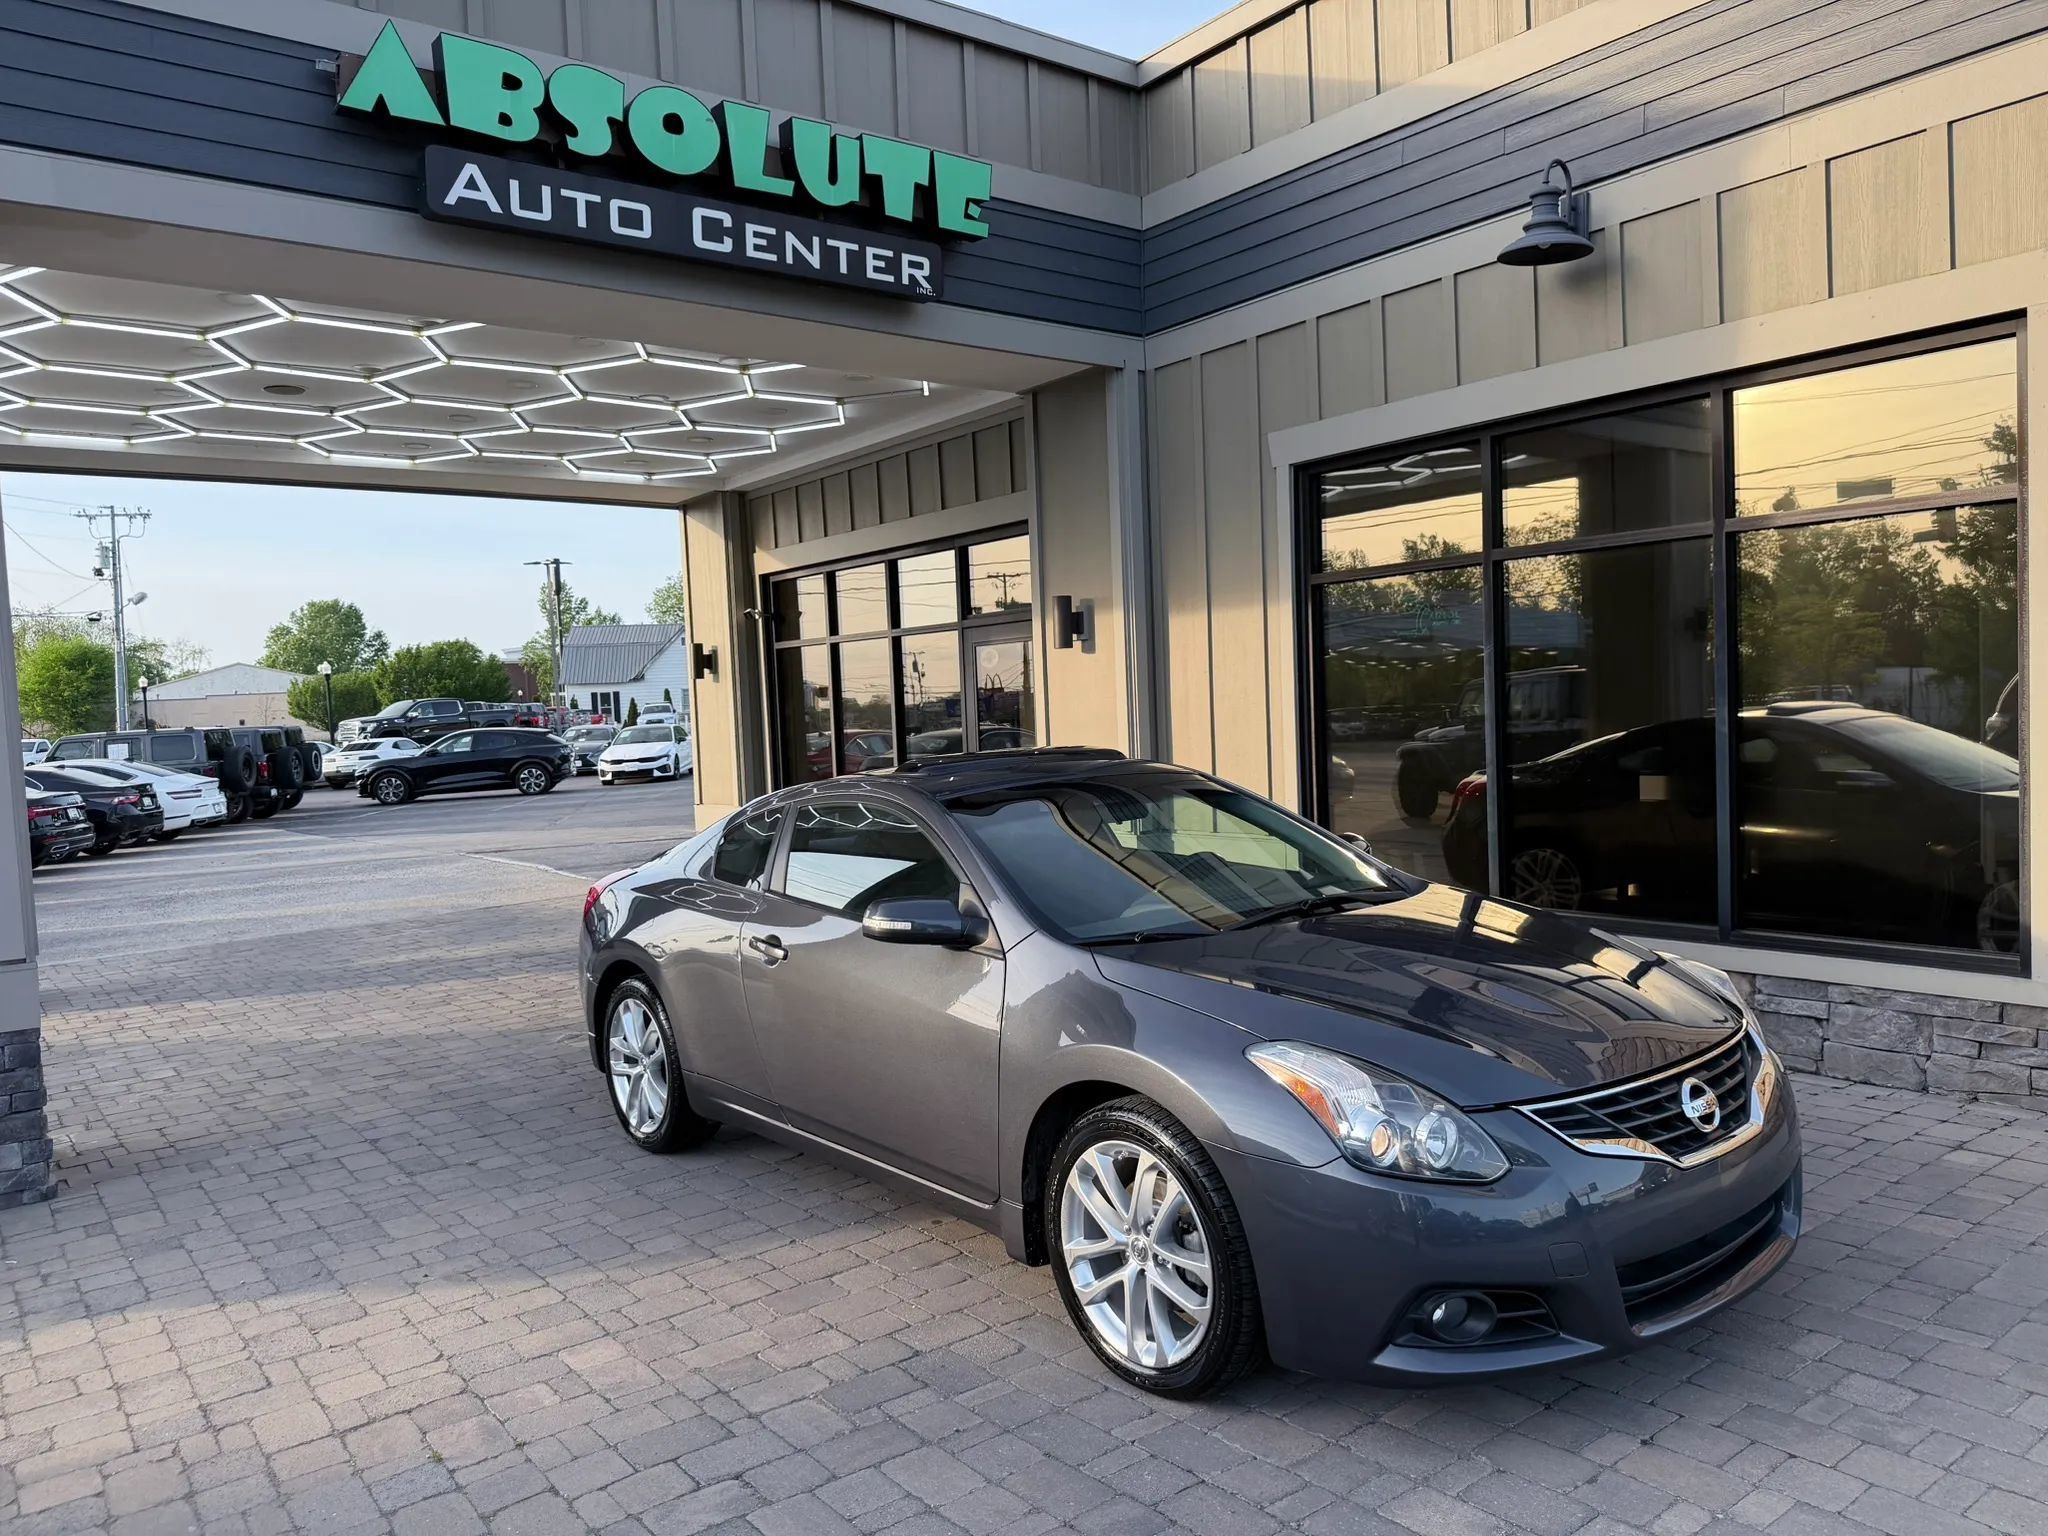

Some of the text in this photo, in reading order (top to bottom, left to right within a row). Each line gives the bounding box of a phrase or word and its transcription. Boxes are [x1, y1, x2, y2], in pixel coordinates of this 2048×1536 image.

[338, 20, 993, 238] ABSOLUTE
[443, 162, 932, 289] AUTO CENTER
[916, 286, 936, 296] INC.
